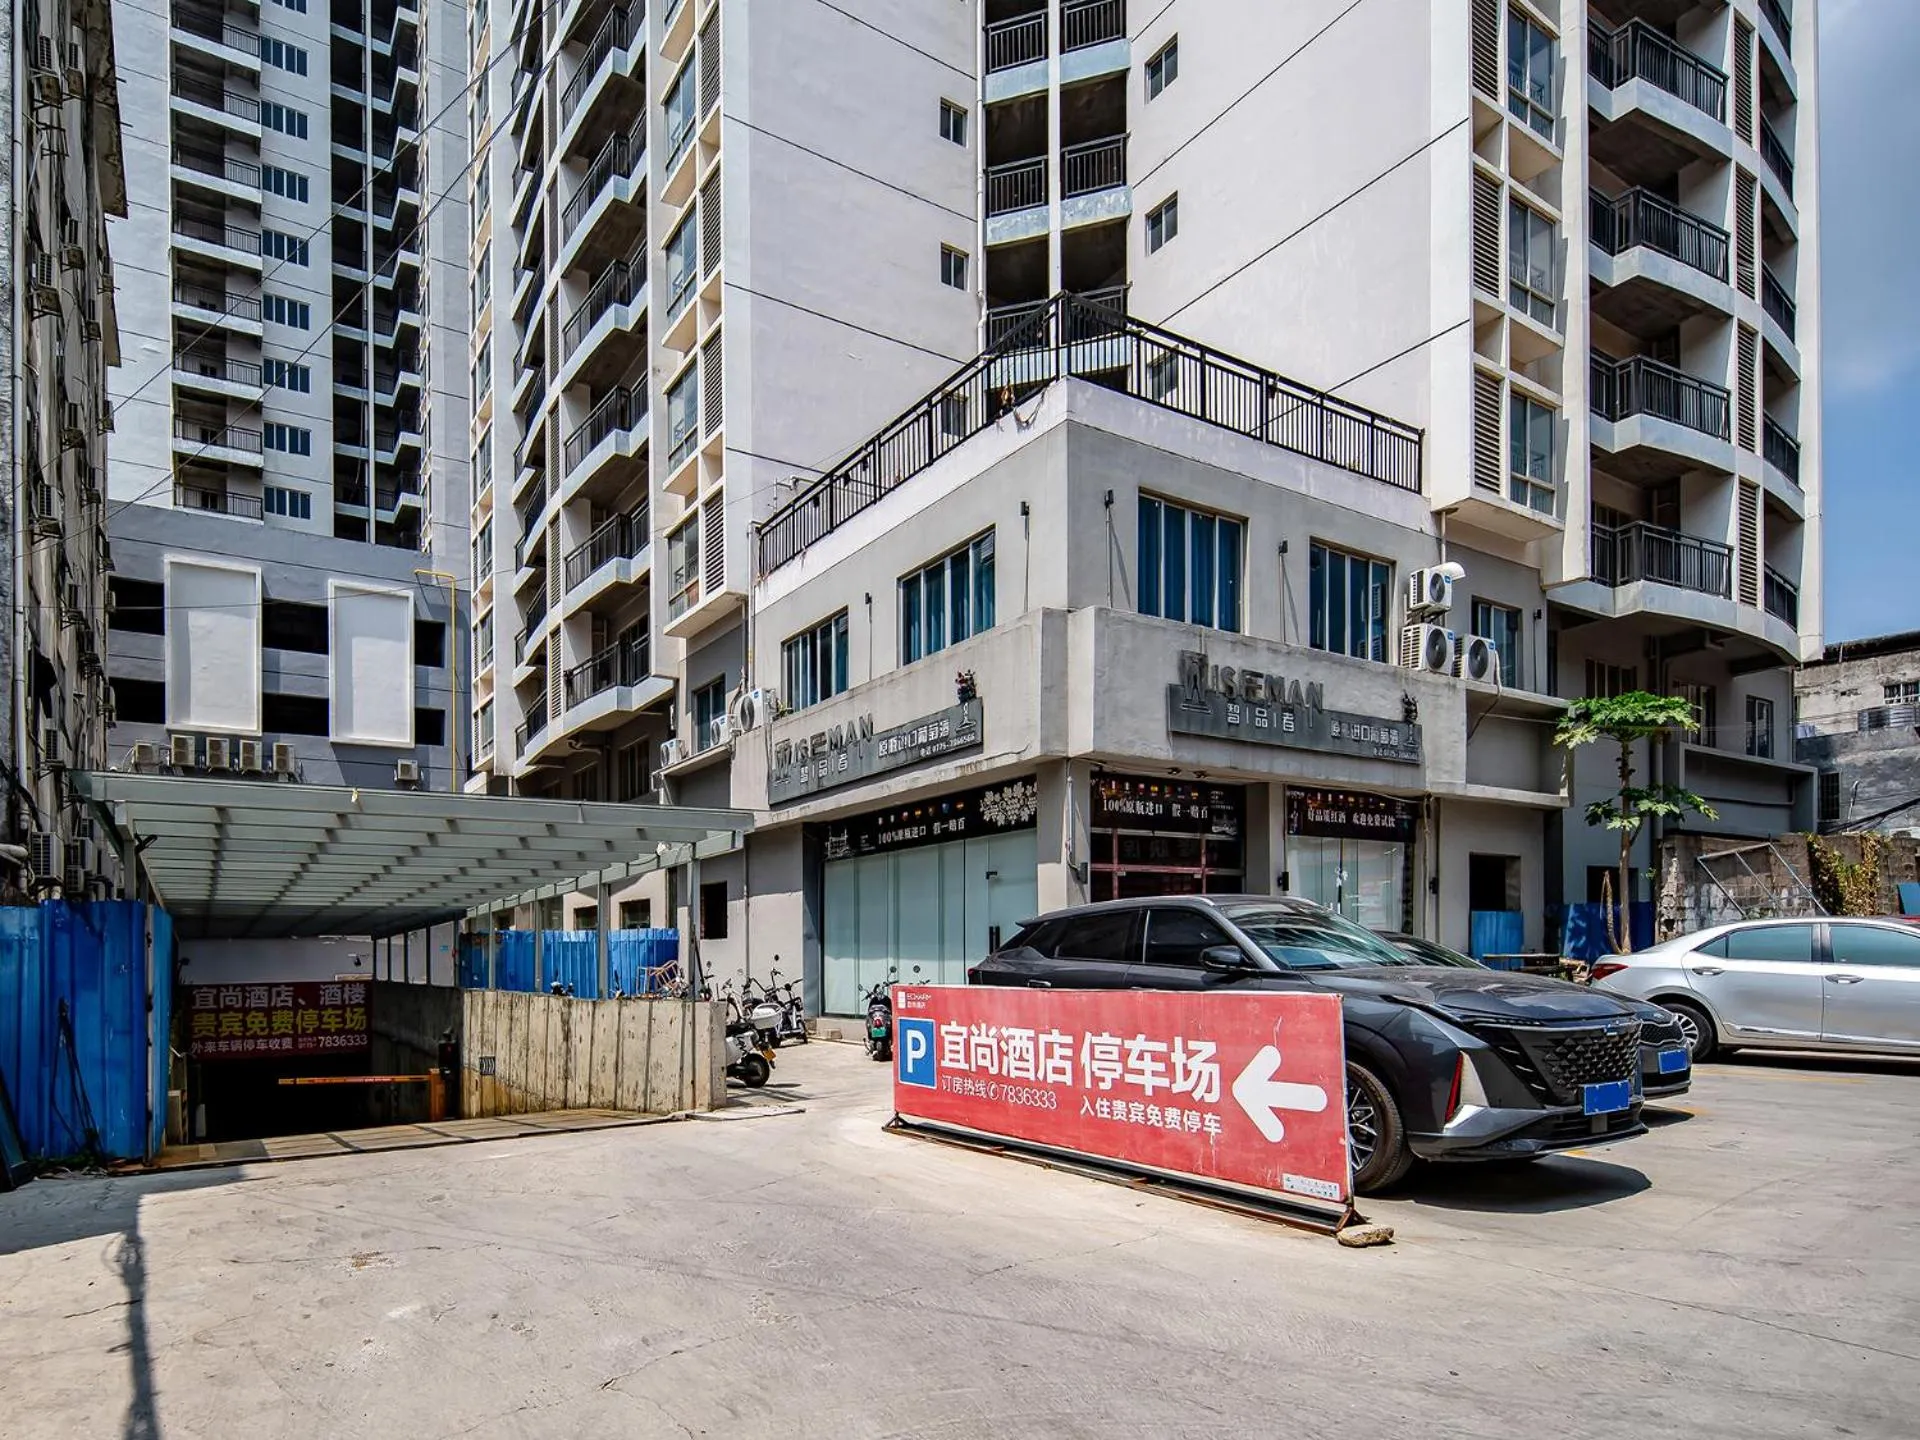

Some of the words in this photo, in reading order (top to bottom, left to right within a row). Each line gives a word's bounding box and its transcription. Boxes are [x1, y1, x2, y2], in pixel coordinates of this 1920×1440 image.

[191, 1007, 368, 1038] 贵宾免费停车场
[191, 1036, 293, 1054] 外来车辆停车收费
[318, 1034, 368, 1049] 7836333
[907, 1029, 927, 1073] P
[940, 1020, 1074, 1087] 宜尚酒店
[1080, 1031, 1221, 1103] 停车场
[1000, 1083, 1057, 1110] 7836333
[1080, 1095, 1223, 1137] 入住贵宾免费停车
